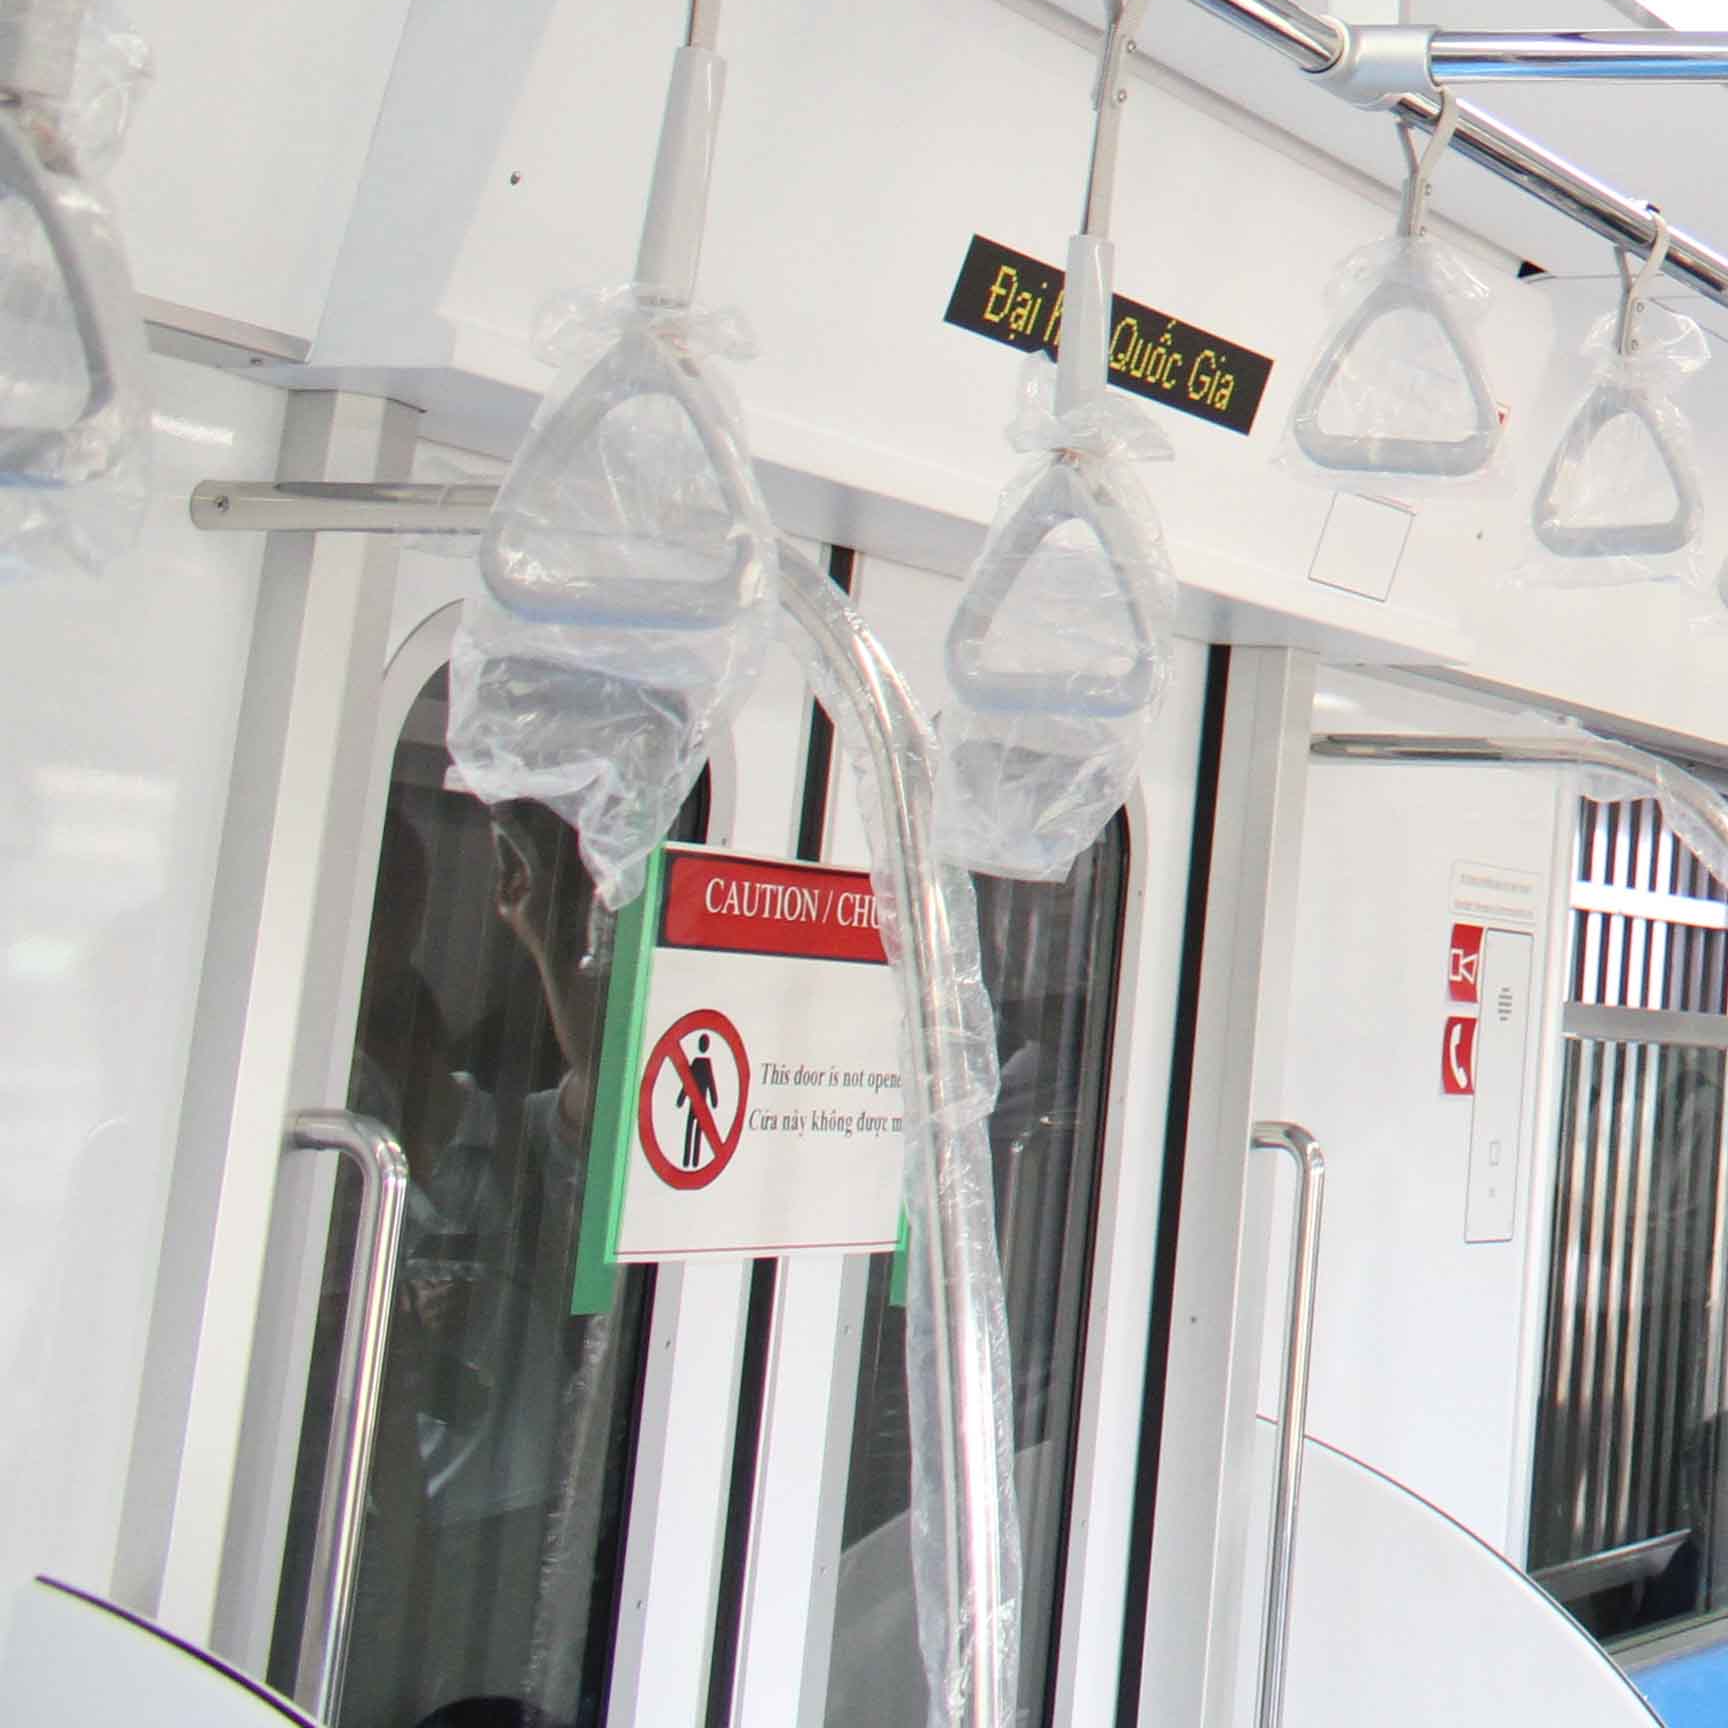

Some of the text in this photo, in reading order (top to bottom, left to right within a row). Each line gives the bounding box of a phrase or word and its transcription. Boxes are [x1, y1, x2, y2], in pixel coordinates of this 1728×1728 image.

[984, 264, 1048, 341] Đại
[1108, 316, 1183, 390] Quốc
[1187, 349, 1235, 411] Gia
[704, 877, 820, 922] CAUTION
[760, 1062, 903, 1094] This door is not opene
